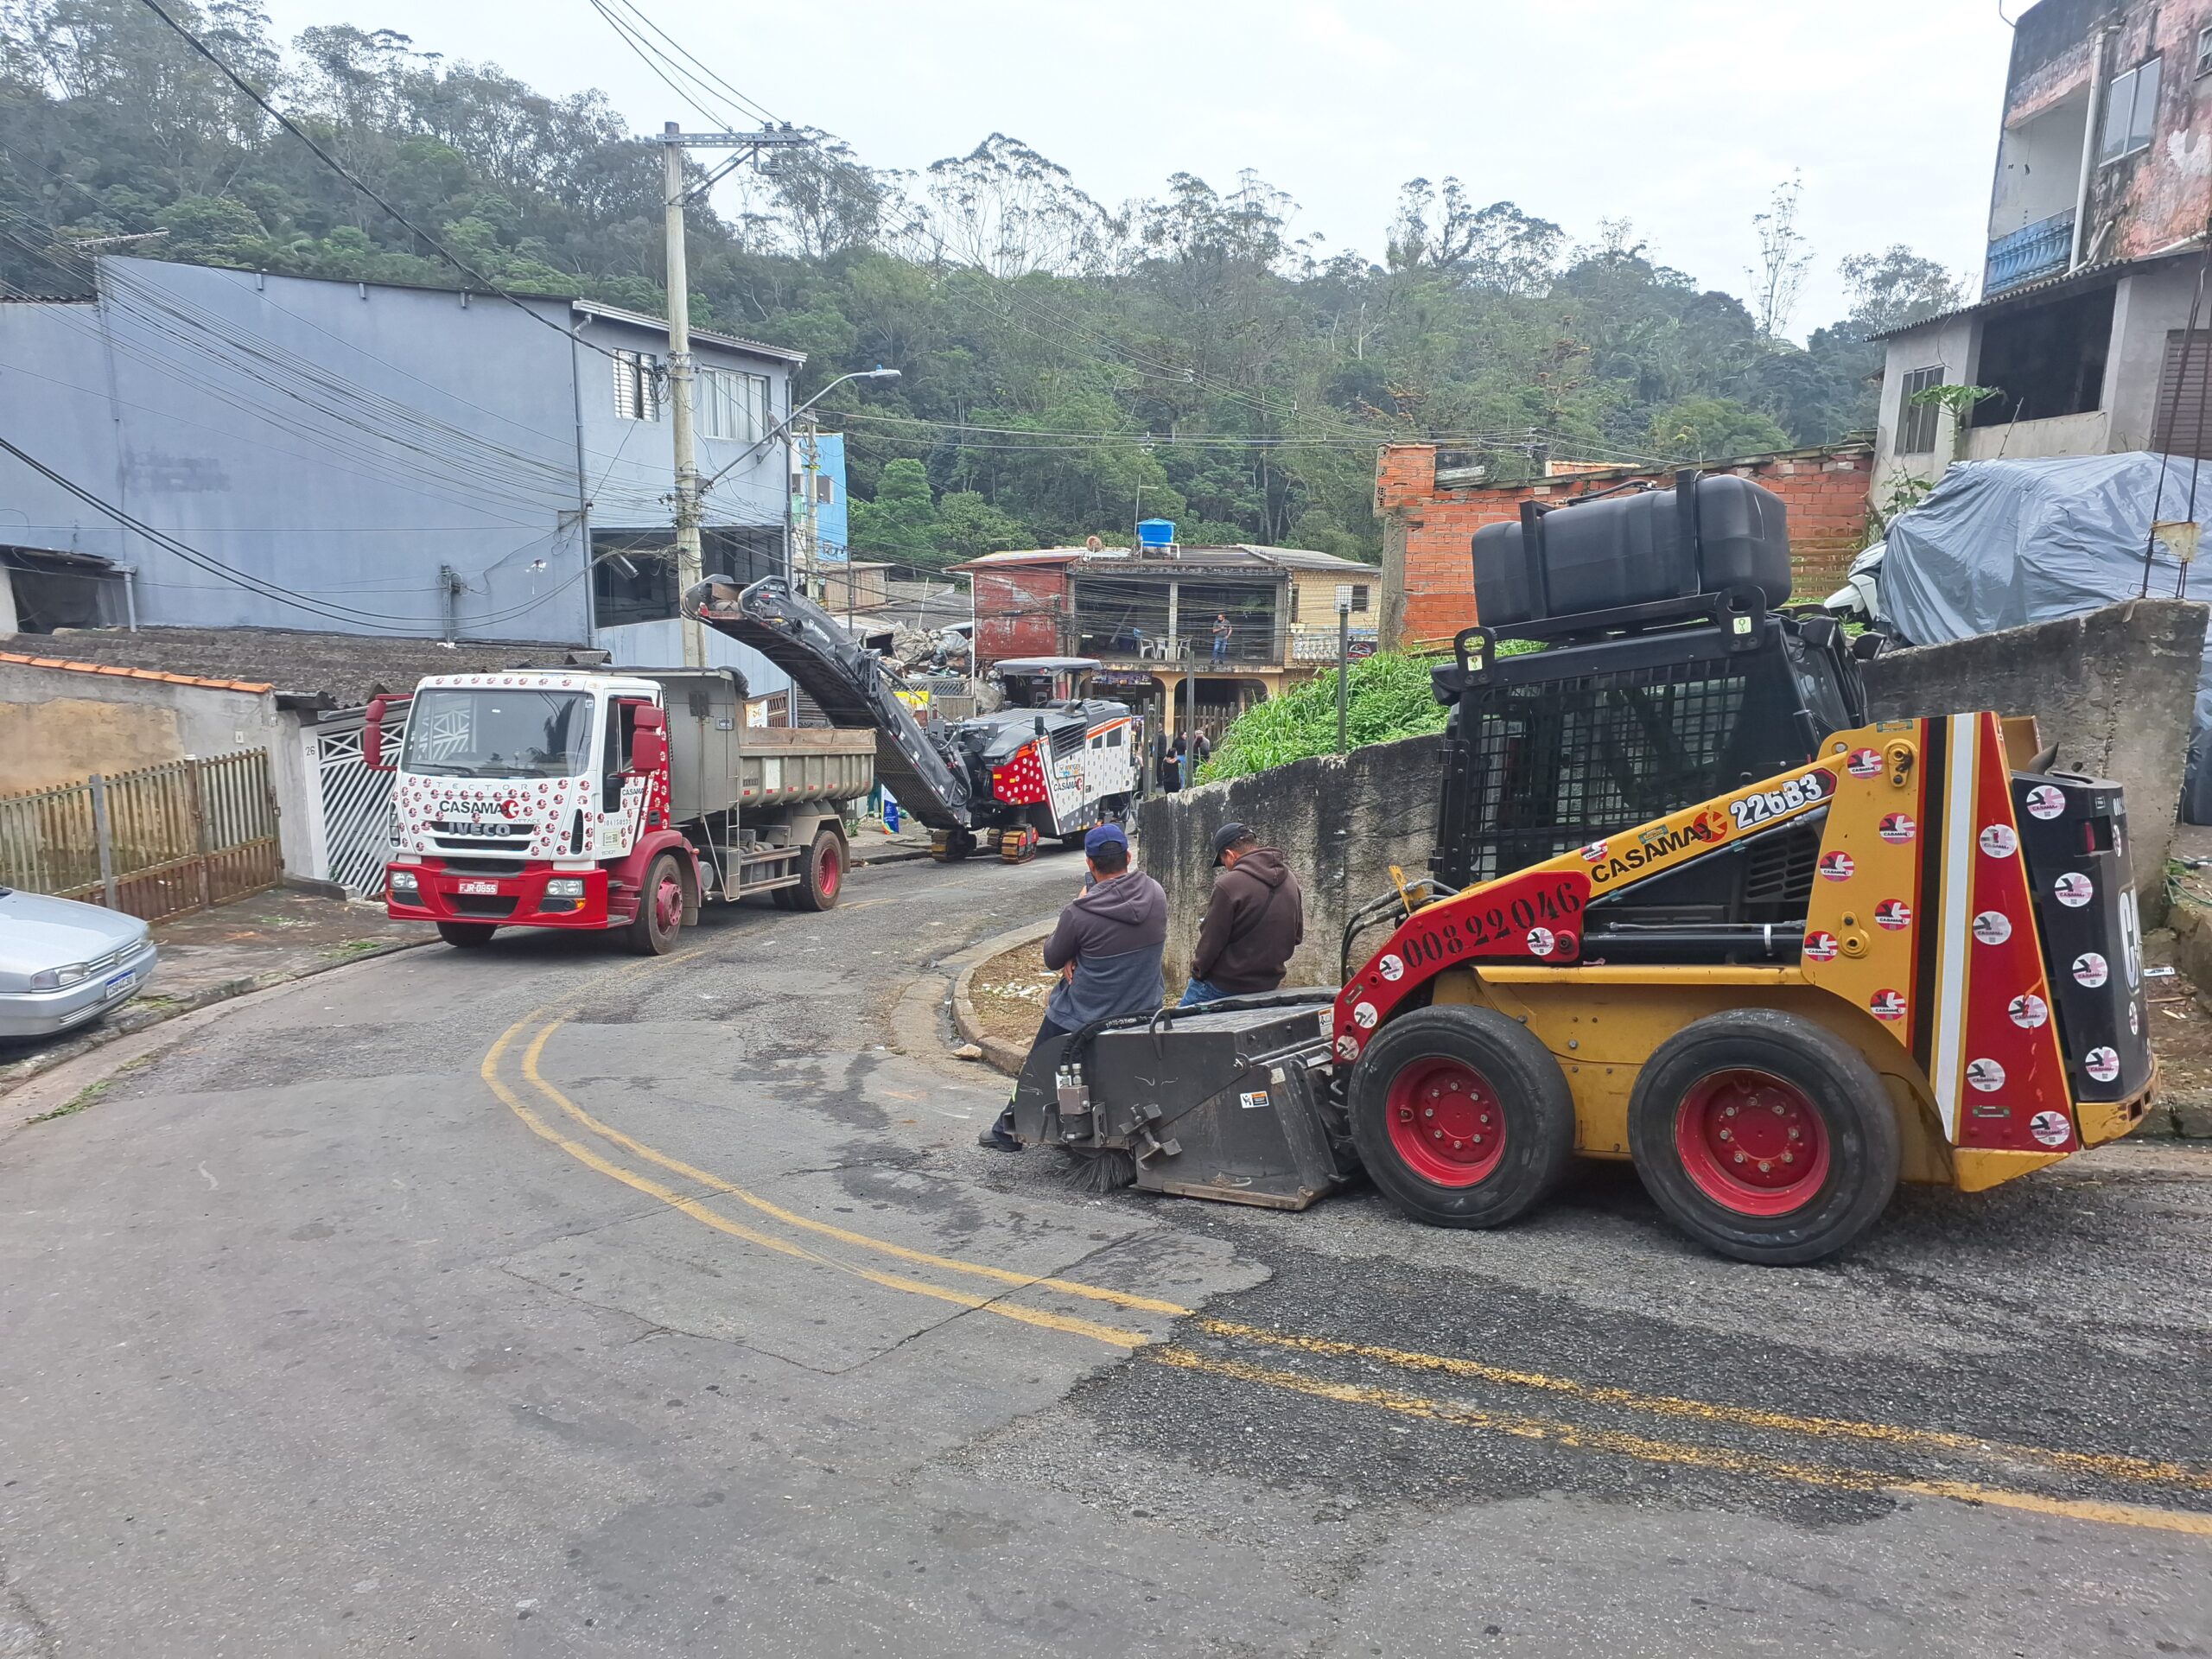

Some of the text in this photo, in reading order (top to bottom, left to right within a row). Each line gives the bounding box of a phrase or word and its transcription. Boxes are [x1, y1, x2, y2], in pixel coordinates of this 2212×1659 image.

[305, 746, 315, 756] 26
[436, 781, 529, 791] TECTOR
[1730, 773, 1822, 829] 226B3
[449, 822, 511, 837] IVECO
